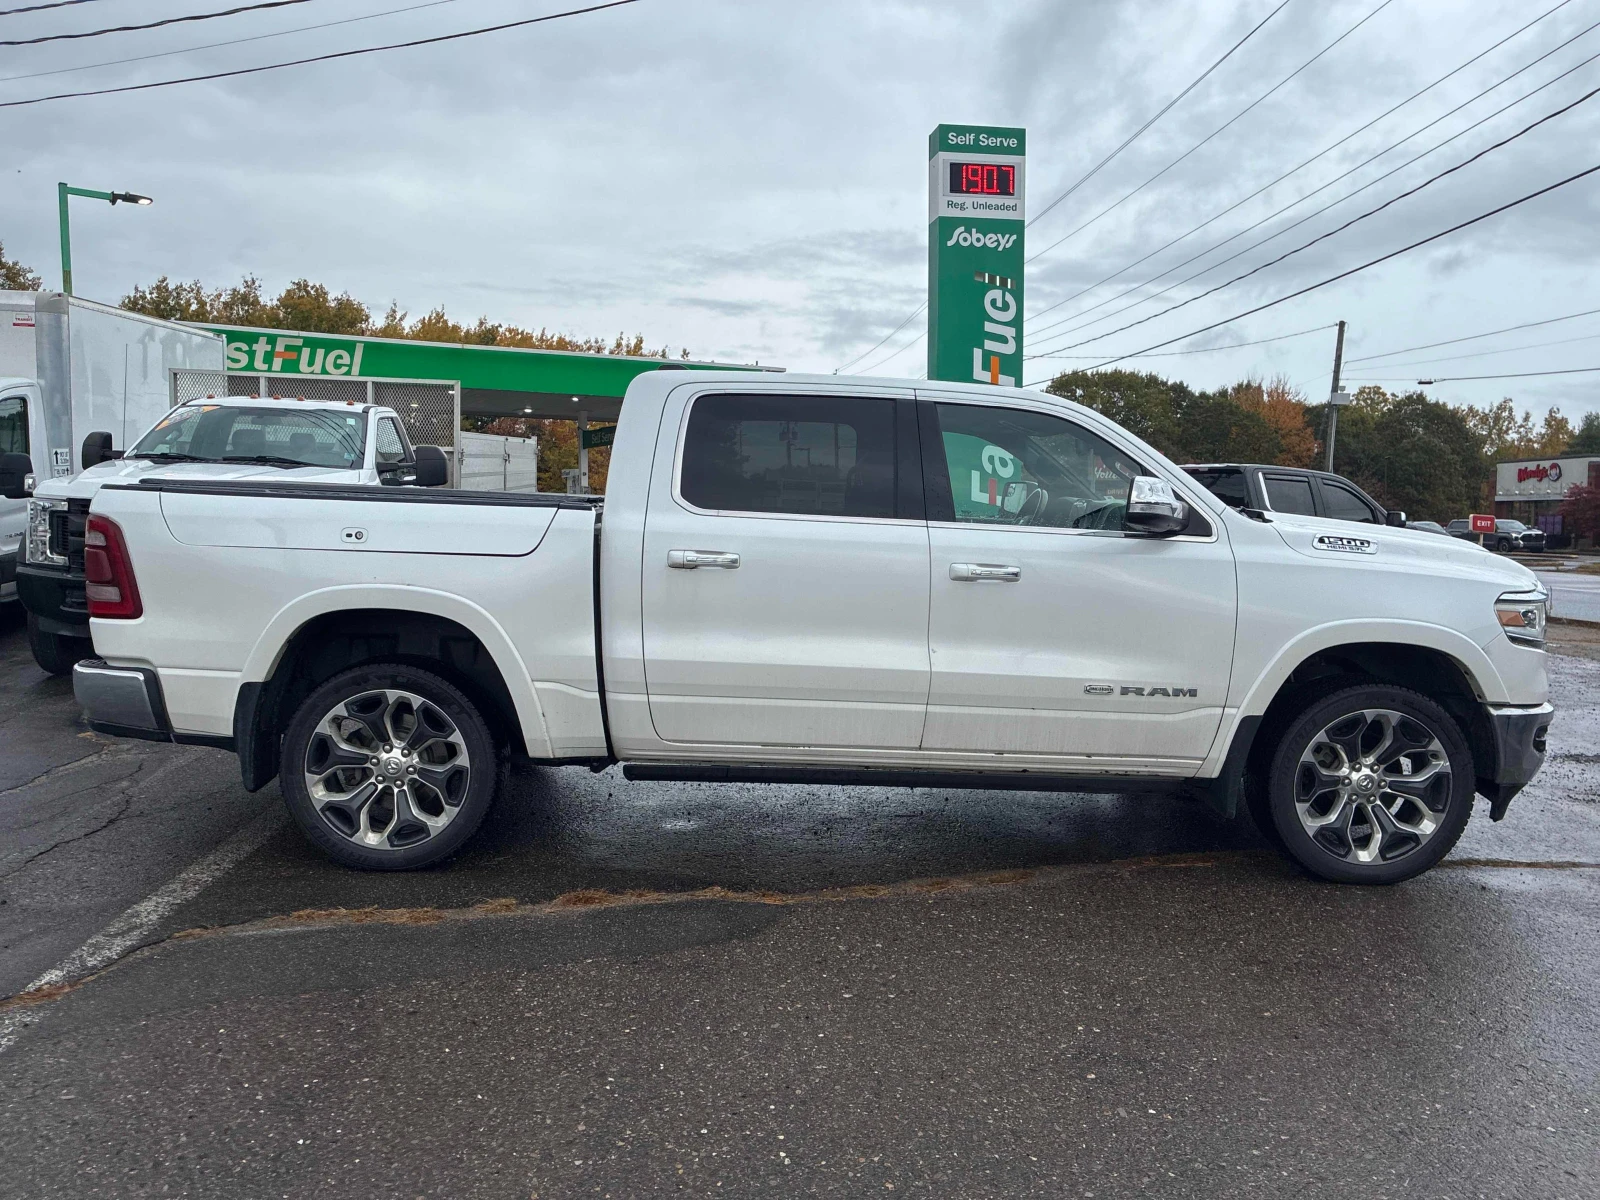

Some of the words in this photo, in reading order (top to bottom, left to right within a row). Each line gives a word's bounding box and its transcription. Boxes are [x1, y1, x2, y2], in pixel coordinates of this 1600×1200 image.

[948, 132, 975, 145] Self
[979, 134, 1018, 148] Serve
[947, 200, 969, 210] Reg.
[972, 201, 1018, 212] Unleaded
[946, 226, 1017, 251] Sobeys
[1517, 464, 1548, 483] Wendy's
[1477, 519, 1491, 527] EXIT
[1322, 536, 1370, 547] 1500
[1120, 686, 1198, 697] RAM
